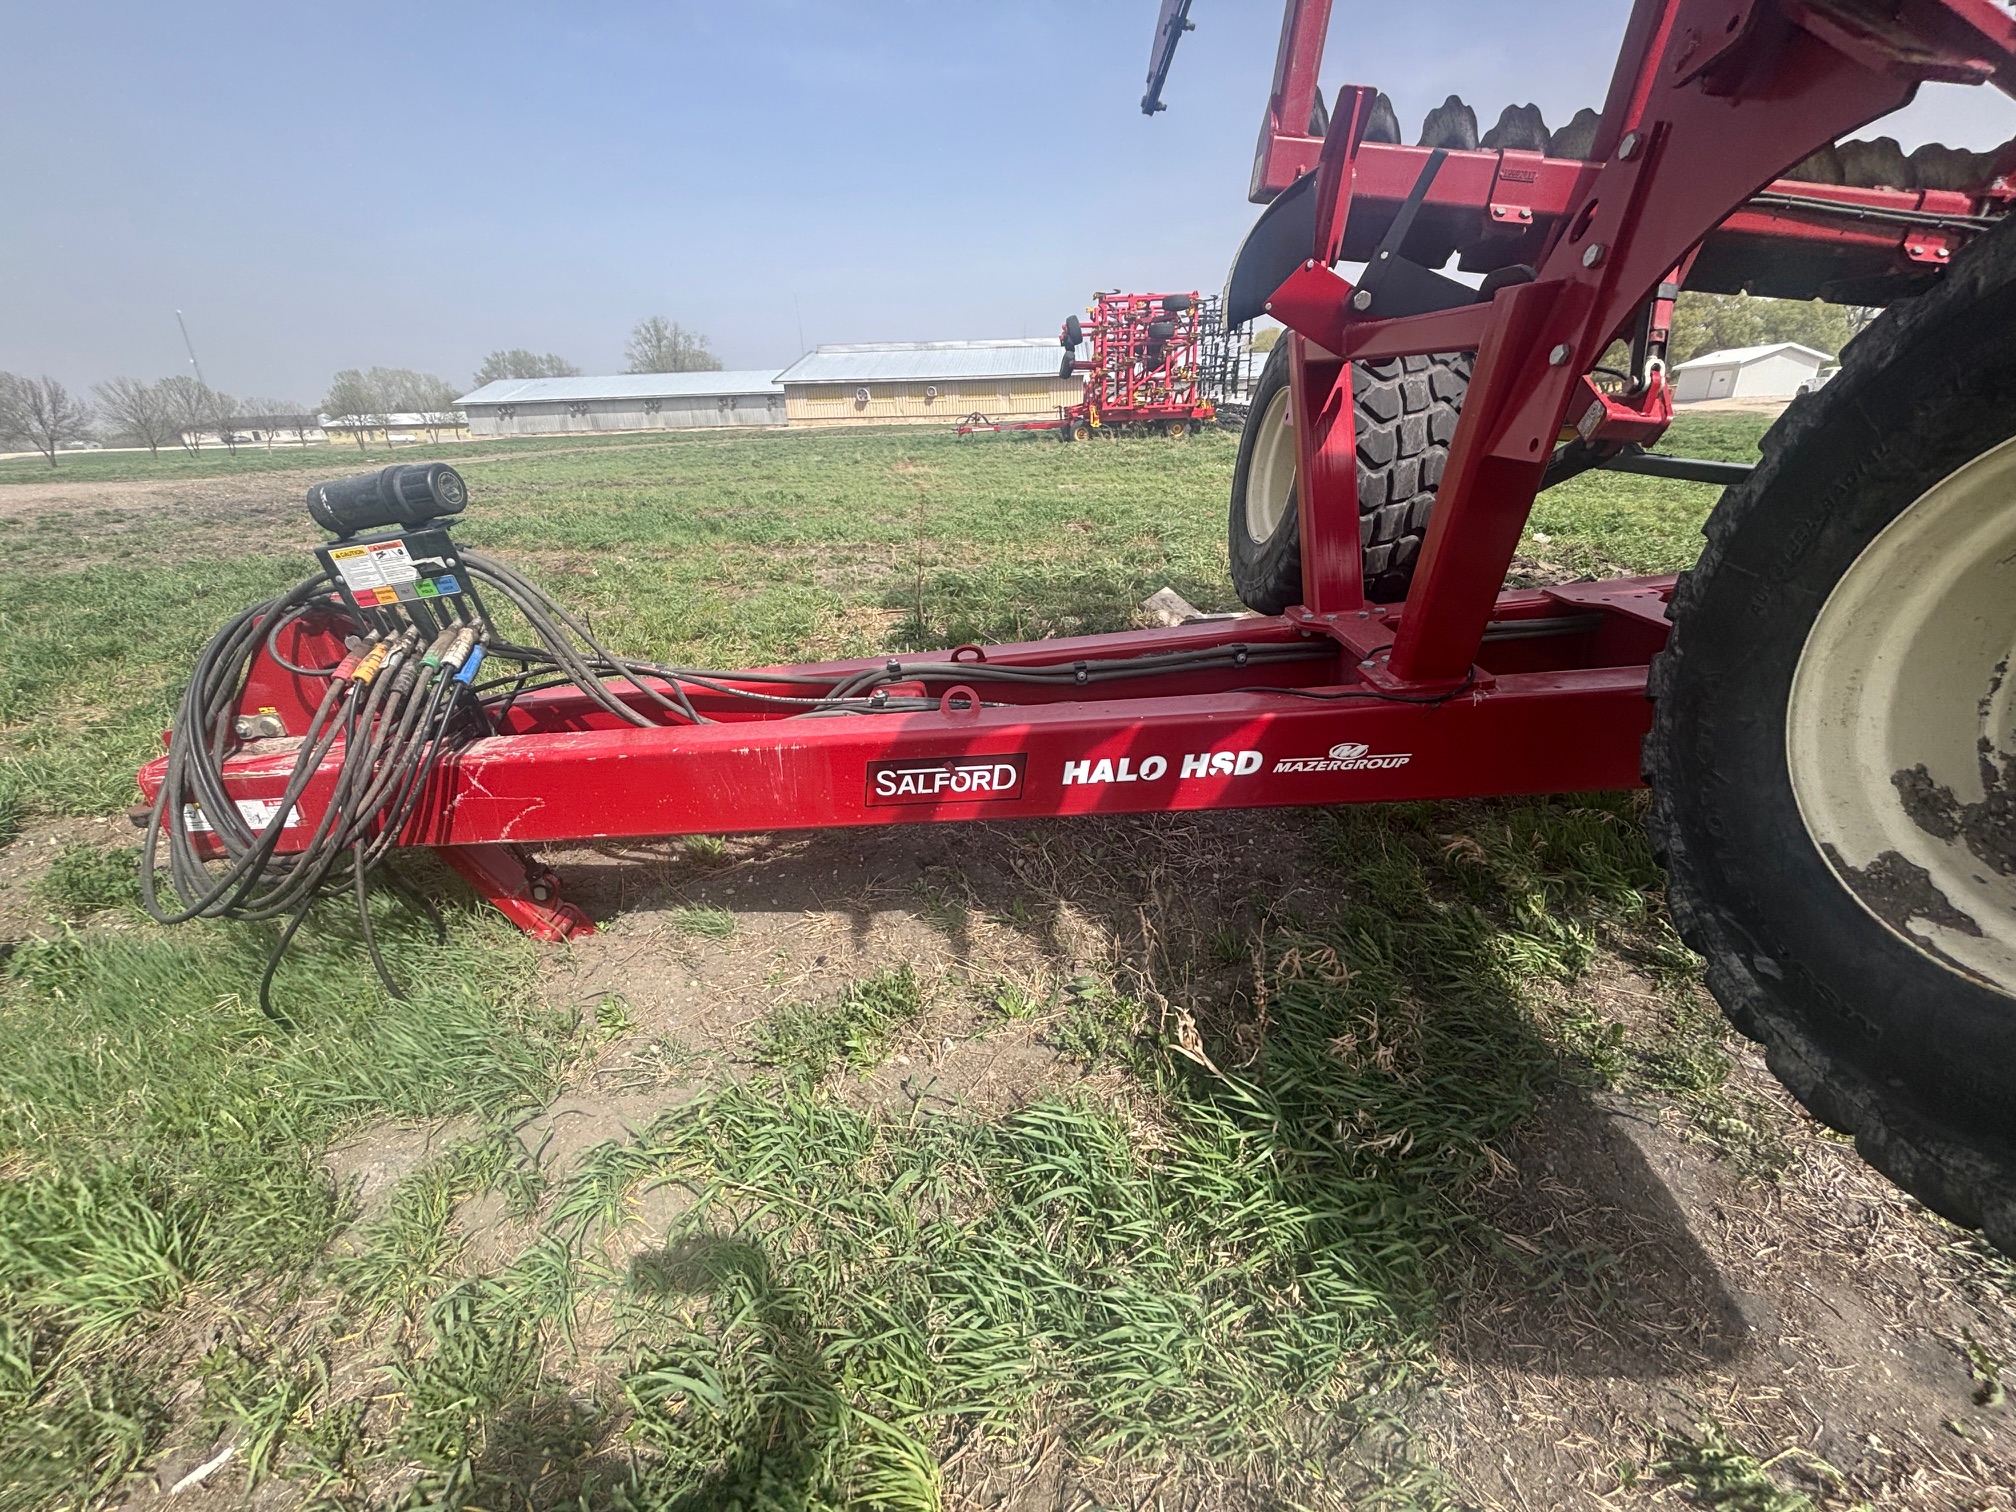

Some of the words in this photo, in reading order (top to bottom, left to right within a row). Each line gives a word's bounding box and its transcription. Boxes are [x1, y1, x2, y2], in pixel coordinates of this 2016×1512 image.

[340, 549, 365, 558] CAUTION
[1062, 755, 1168, 785] HALO
[1179, 750, 1264, 779] HSD
[1272, 757, 1411, 774] MAZERGROUP
[875, 764, 1017, 796] SALFORD
